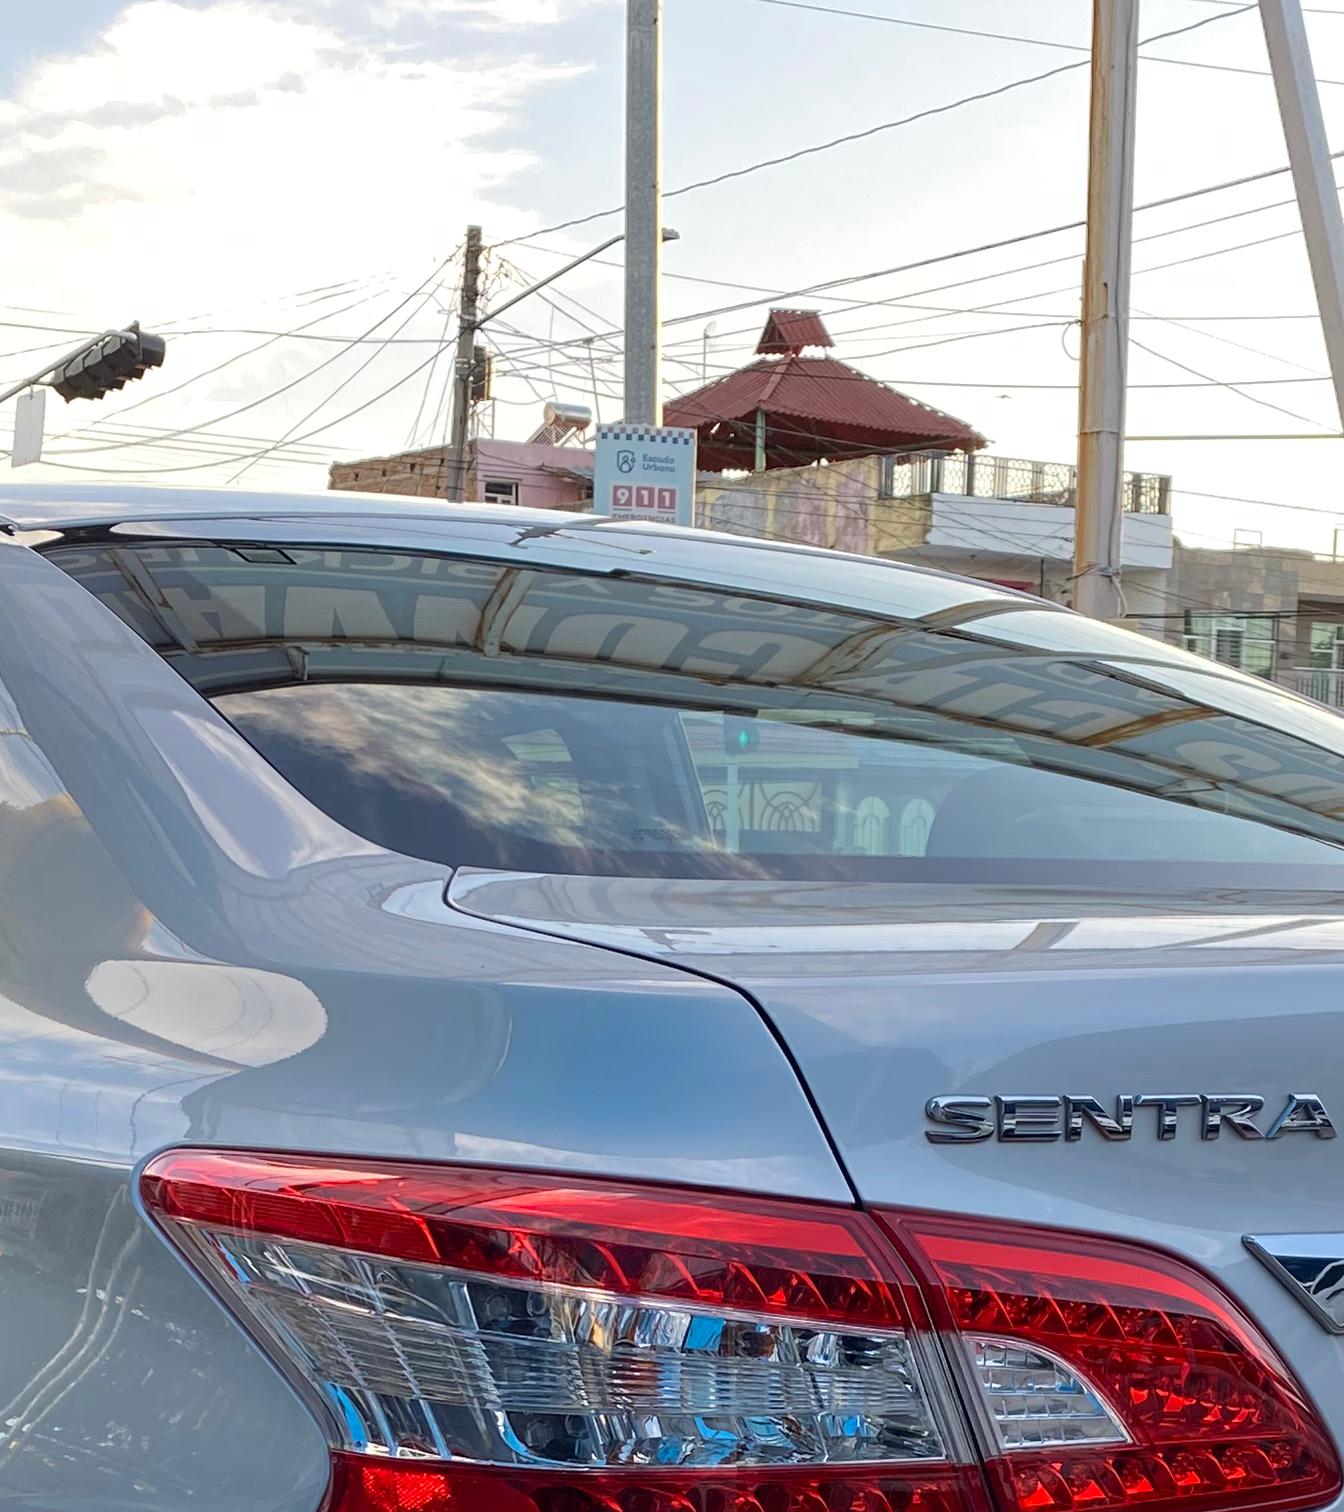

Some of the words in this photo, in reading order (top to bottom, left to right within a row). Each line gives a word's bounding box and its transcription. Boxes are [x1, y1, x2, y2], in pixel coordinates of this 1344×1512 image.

[642, 454, 676, 464] Escudo
[642, 463, 676, 473] Urbano
[615, 487, 672, 508] 911
[925, 1094, 1338, 1143] SENTRA
